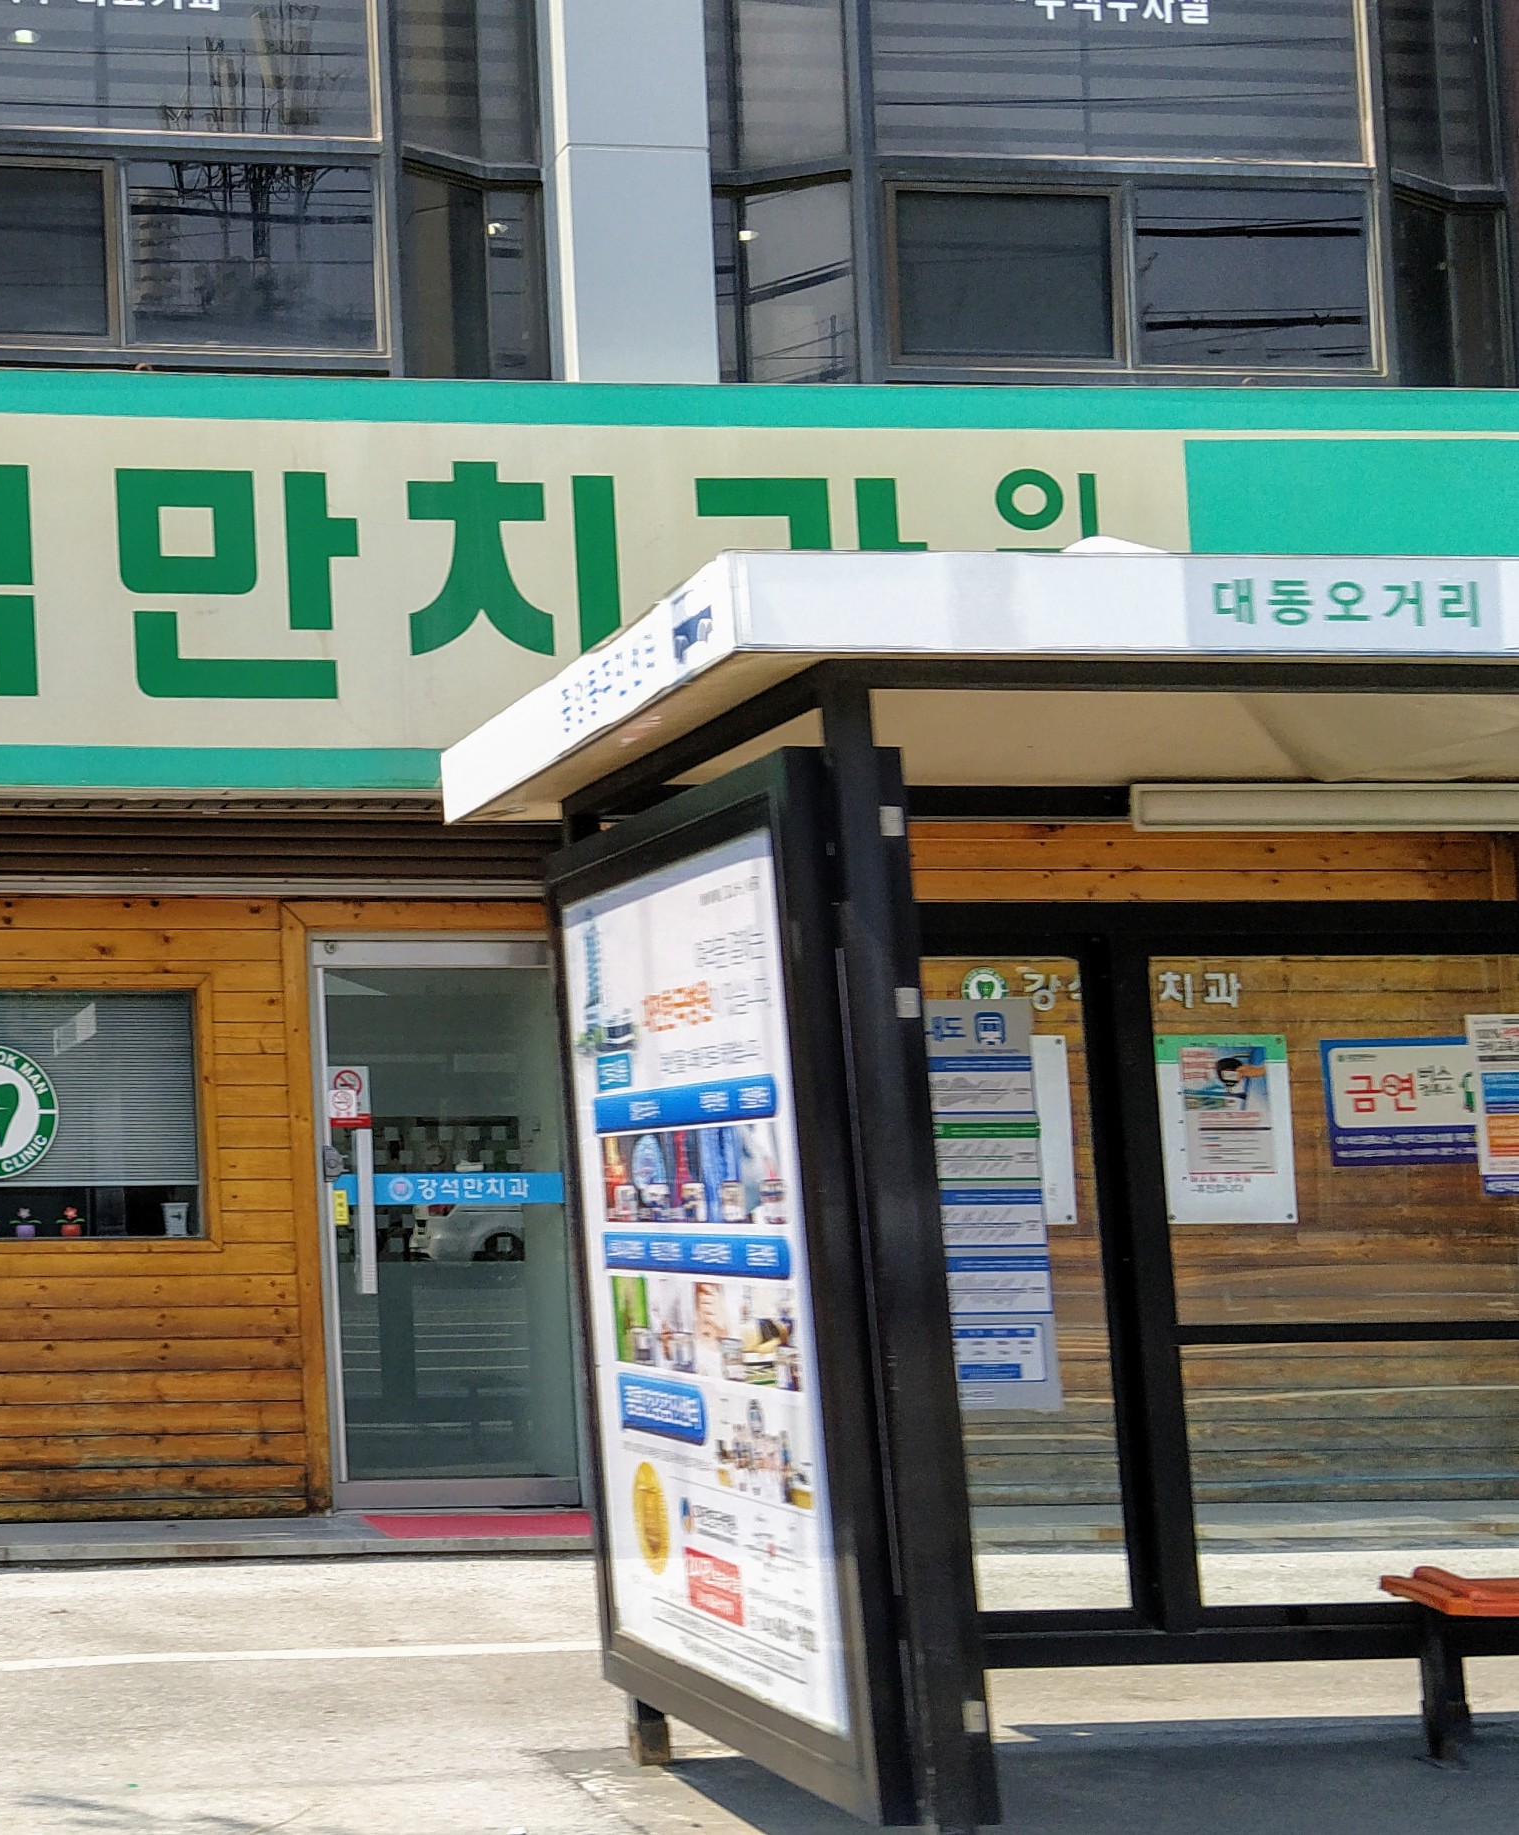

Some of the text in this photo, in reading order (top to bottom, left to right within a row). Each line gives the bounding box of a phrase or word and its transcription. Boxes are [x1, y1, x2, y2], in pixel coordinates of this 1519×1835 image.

[1212, 577, 1482, 628] 대동오거리
[19, 1062, 49, 1095] MAN
[1344, 1071, 1419, 1113] 금연
[1, 1134, 48, 1172] CLINIC
[416, 1177, 531, 1201] 강석만치과
